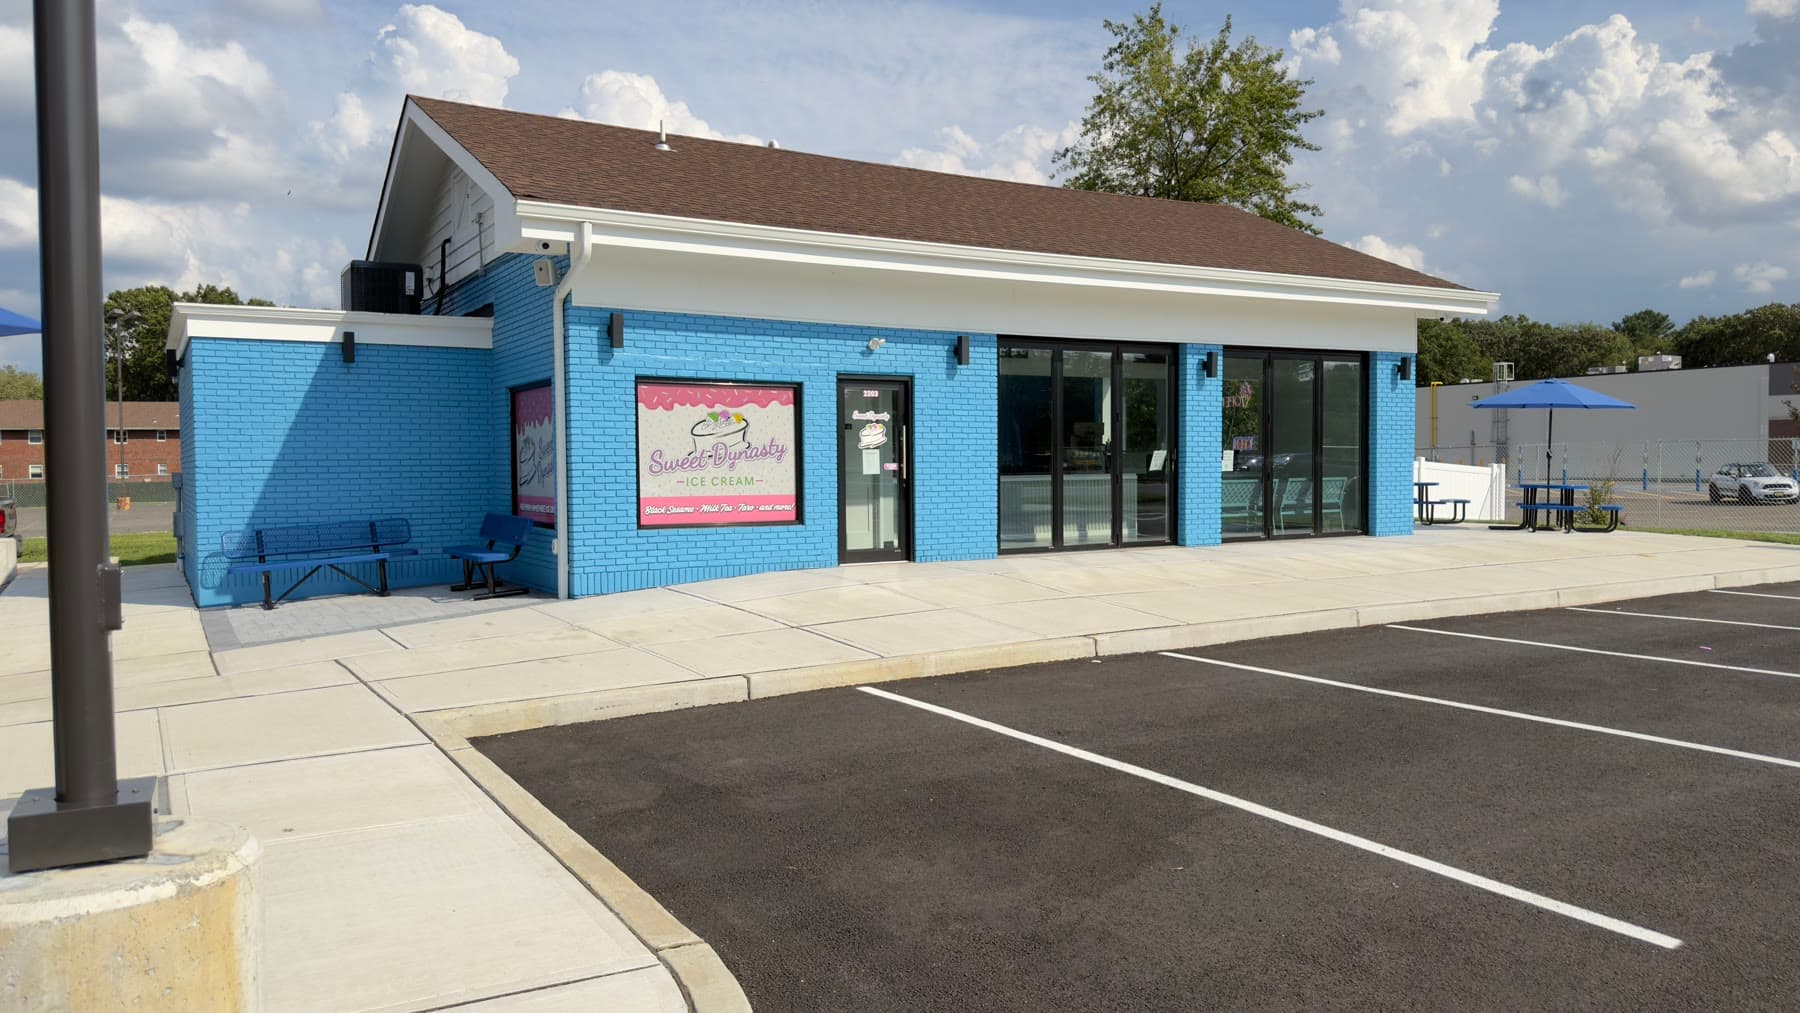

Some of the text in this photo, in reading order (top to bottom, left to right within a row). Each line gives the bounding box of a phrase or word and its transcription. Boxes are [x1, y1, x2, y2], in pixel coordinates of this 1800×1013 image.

[649, 437, 786, 475] Sweet Dynasty
[686, 476, 755, 487] ICE CREAM
[645, 505, 666, 515] Black
[700, 503, 720, 513] Milk
[720, 503, 733, 512] Tea
[759, 503, 774, 511] and
